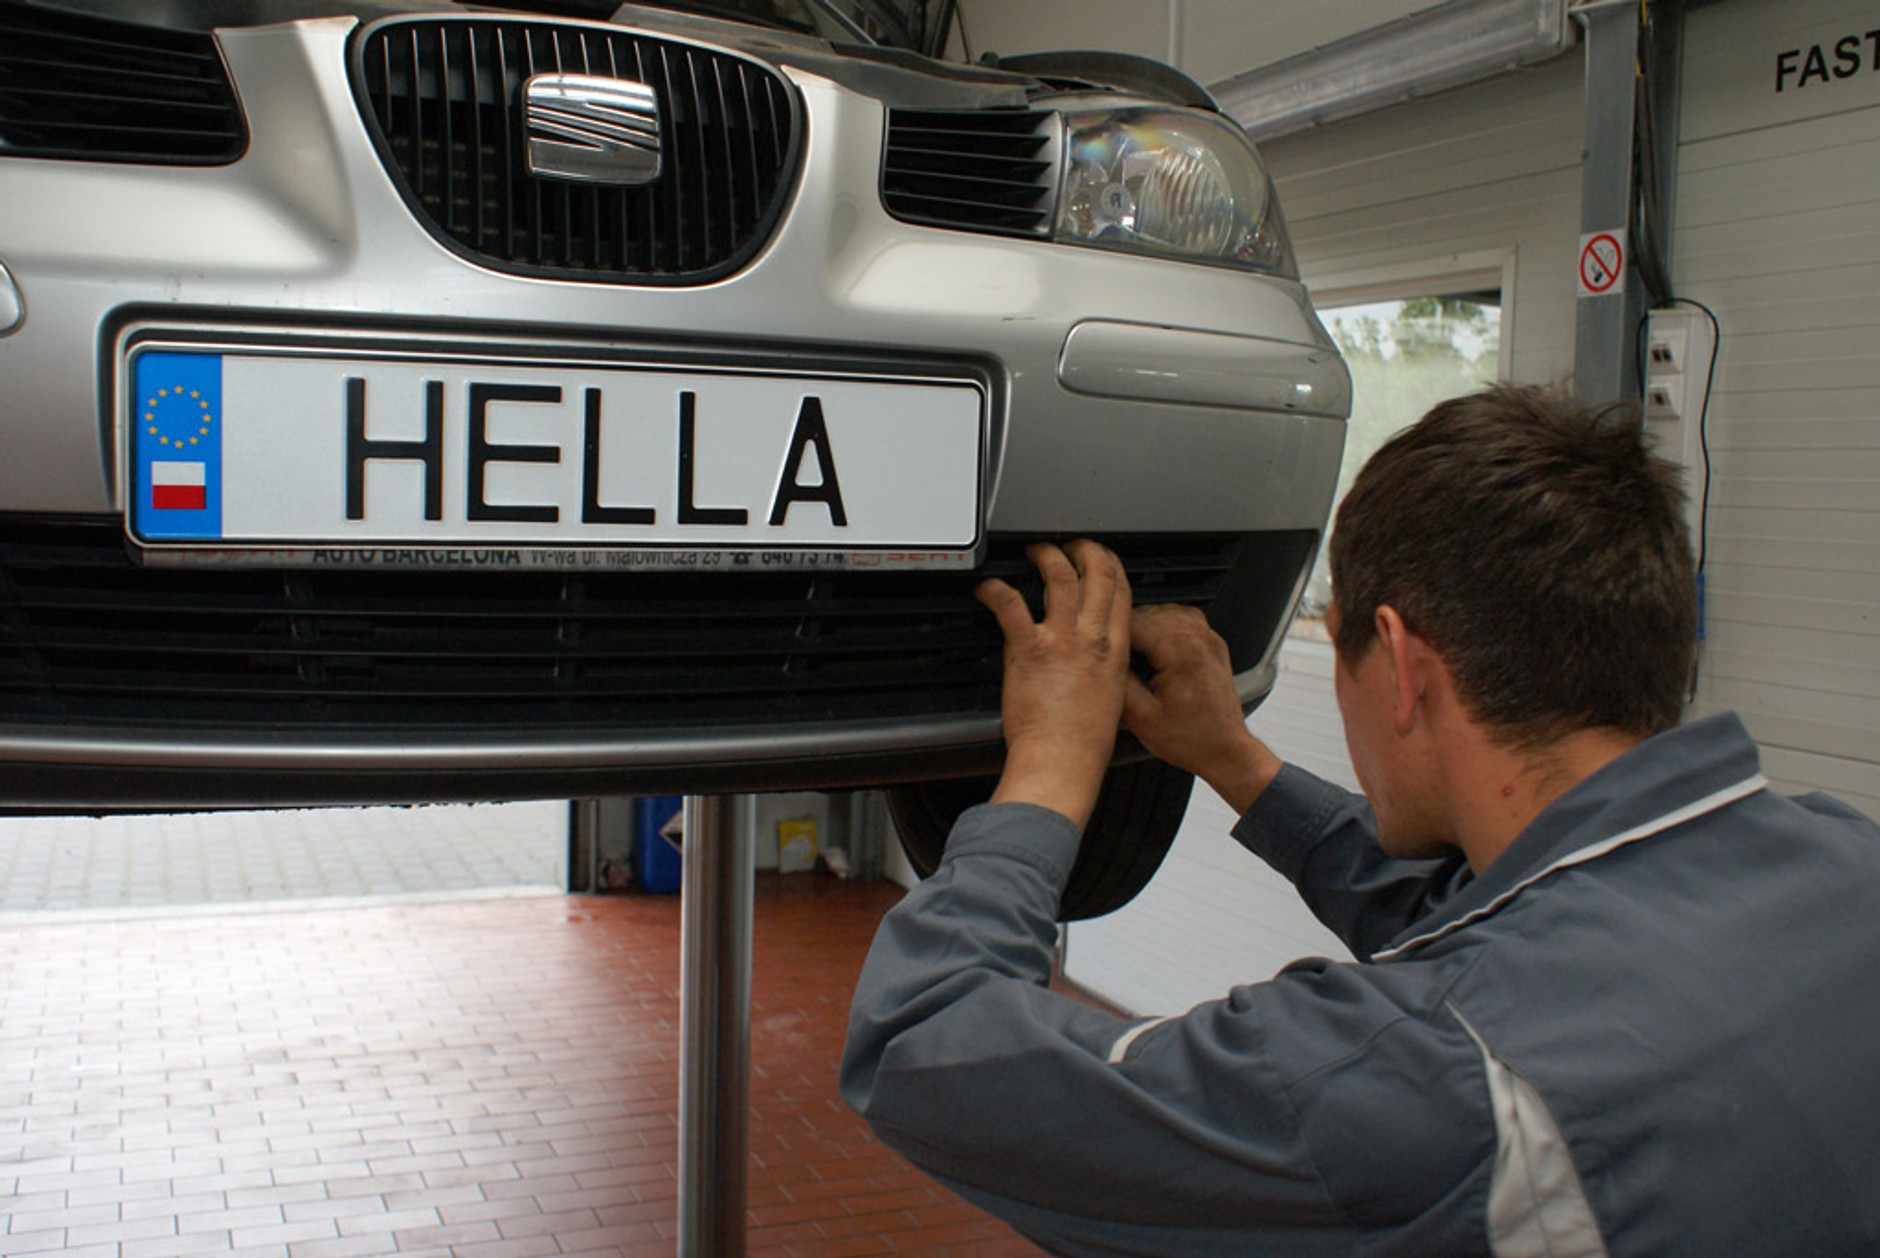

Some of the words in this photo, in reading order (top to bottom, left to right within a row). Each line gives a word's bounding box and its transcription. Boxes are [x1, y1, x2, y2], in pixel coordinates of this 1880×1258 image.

[1775, 28, 1880, 93] FAST
[345, 376, 848, 527] HELLA
[383, 549, 521, 564] BARCELONA
